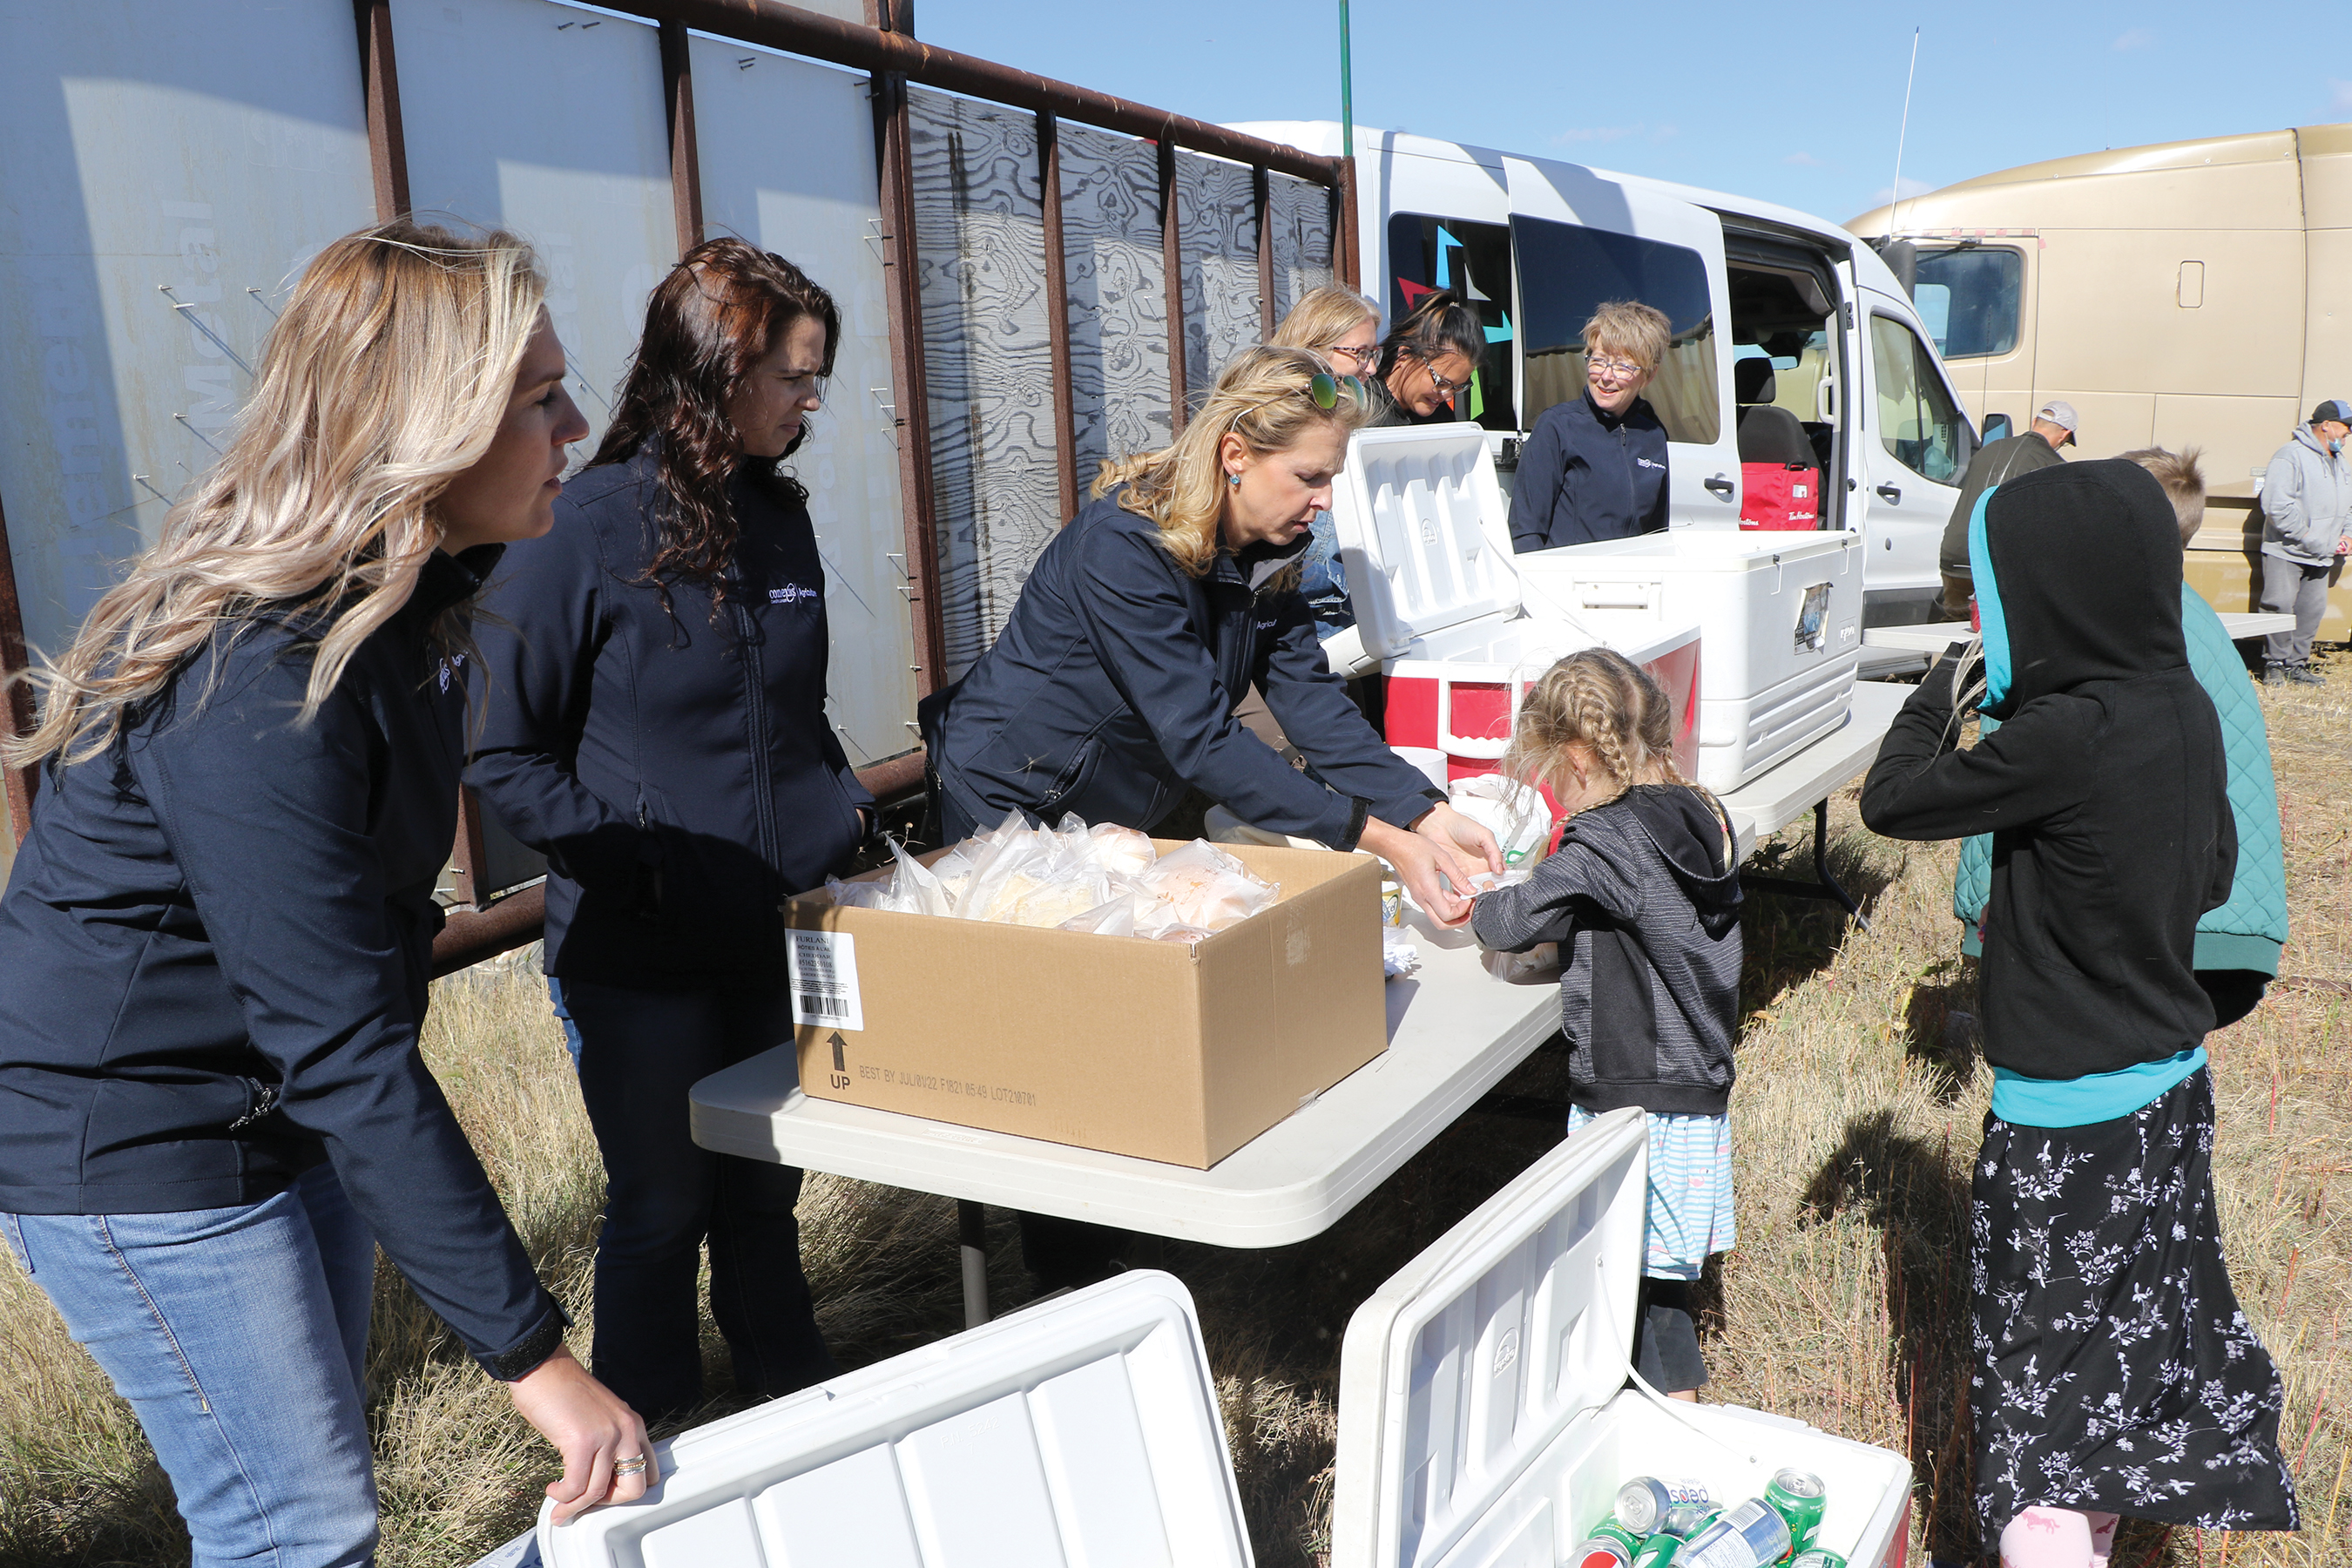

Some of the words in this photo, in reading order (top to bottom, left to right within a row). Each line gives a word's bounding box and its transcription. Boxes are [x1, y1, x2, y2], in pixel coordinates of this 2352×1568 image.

[795, 936, 830, 945] FURLANI
[830, 1074, 851, 1090] UP
[859, 1064, 882, 1081] BEST
[883, 1069, 896, 1083] BY
[899, 1072, 938, 1091] JUL/01/22
[940, 1077, 963, 1094] F1821
[965, 1083, 987, 1098] 05:49
[990, 1087, 1037, 1106] LOT210701
[1670, 1484, 1708, 1504] peps
